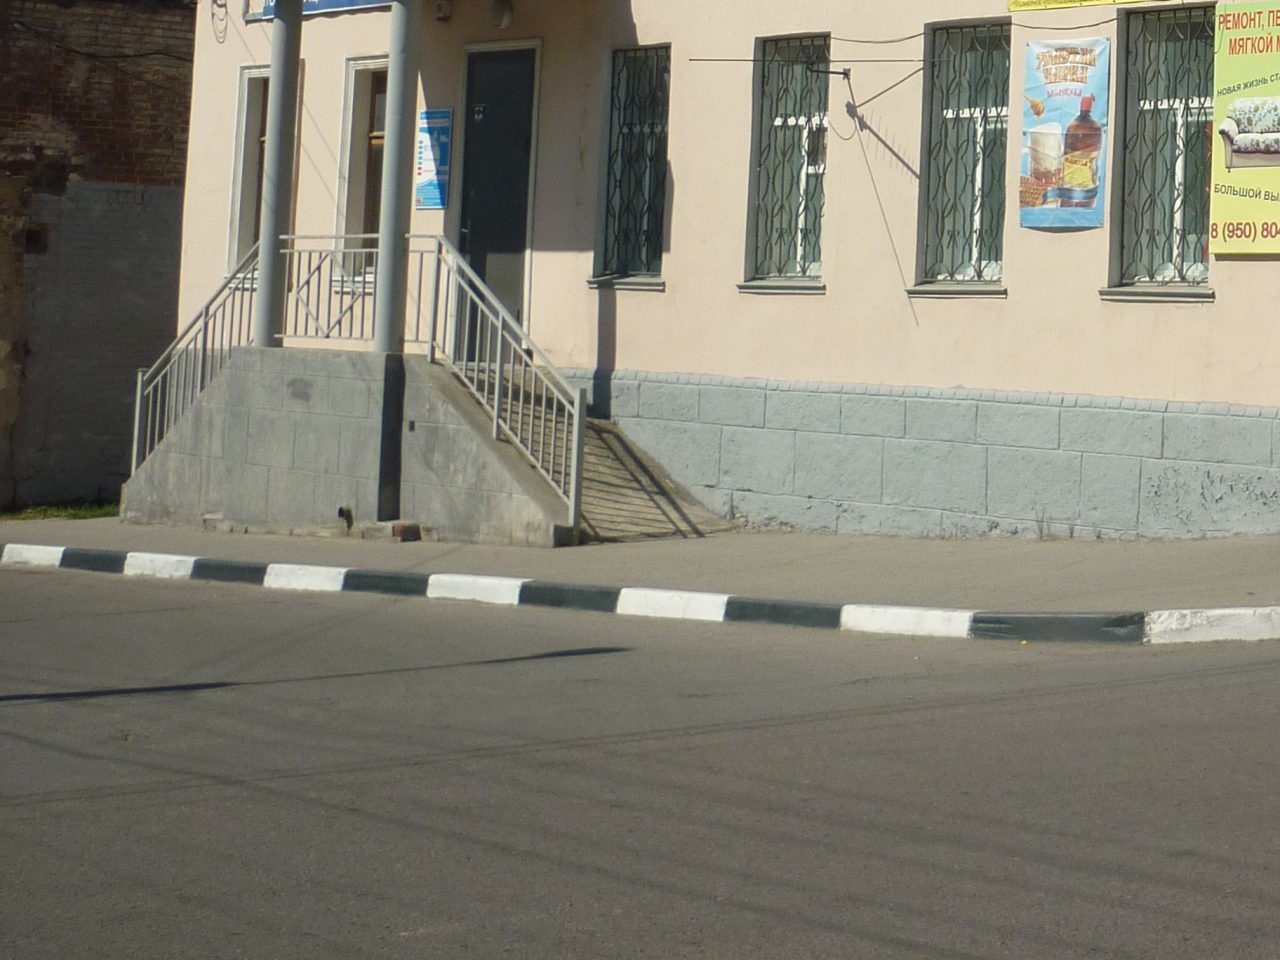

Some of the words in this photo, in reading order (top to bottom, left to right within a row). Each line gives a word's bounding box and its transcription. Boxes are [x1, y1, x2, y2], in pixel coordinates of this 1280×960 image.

[1218, 11, 1265, 31] РЕМОНТ,
[1229, 32, 1273, 55] МЯГКОЙ
[1217, 84, 1241, 97] НОВАЯ
[1242, 77, 1269, 90] ЖИЗНЬ
[1213, 183, 1262, 199] БОЛЬШОЙ
[1210, 222, 1218, 239] 8
[1222, 221, 1257, 243] (950)
